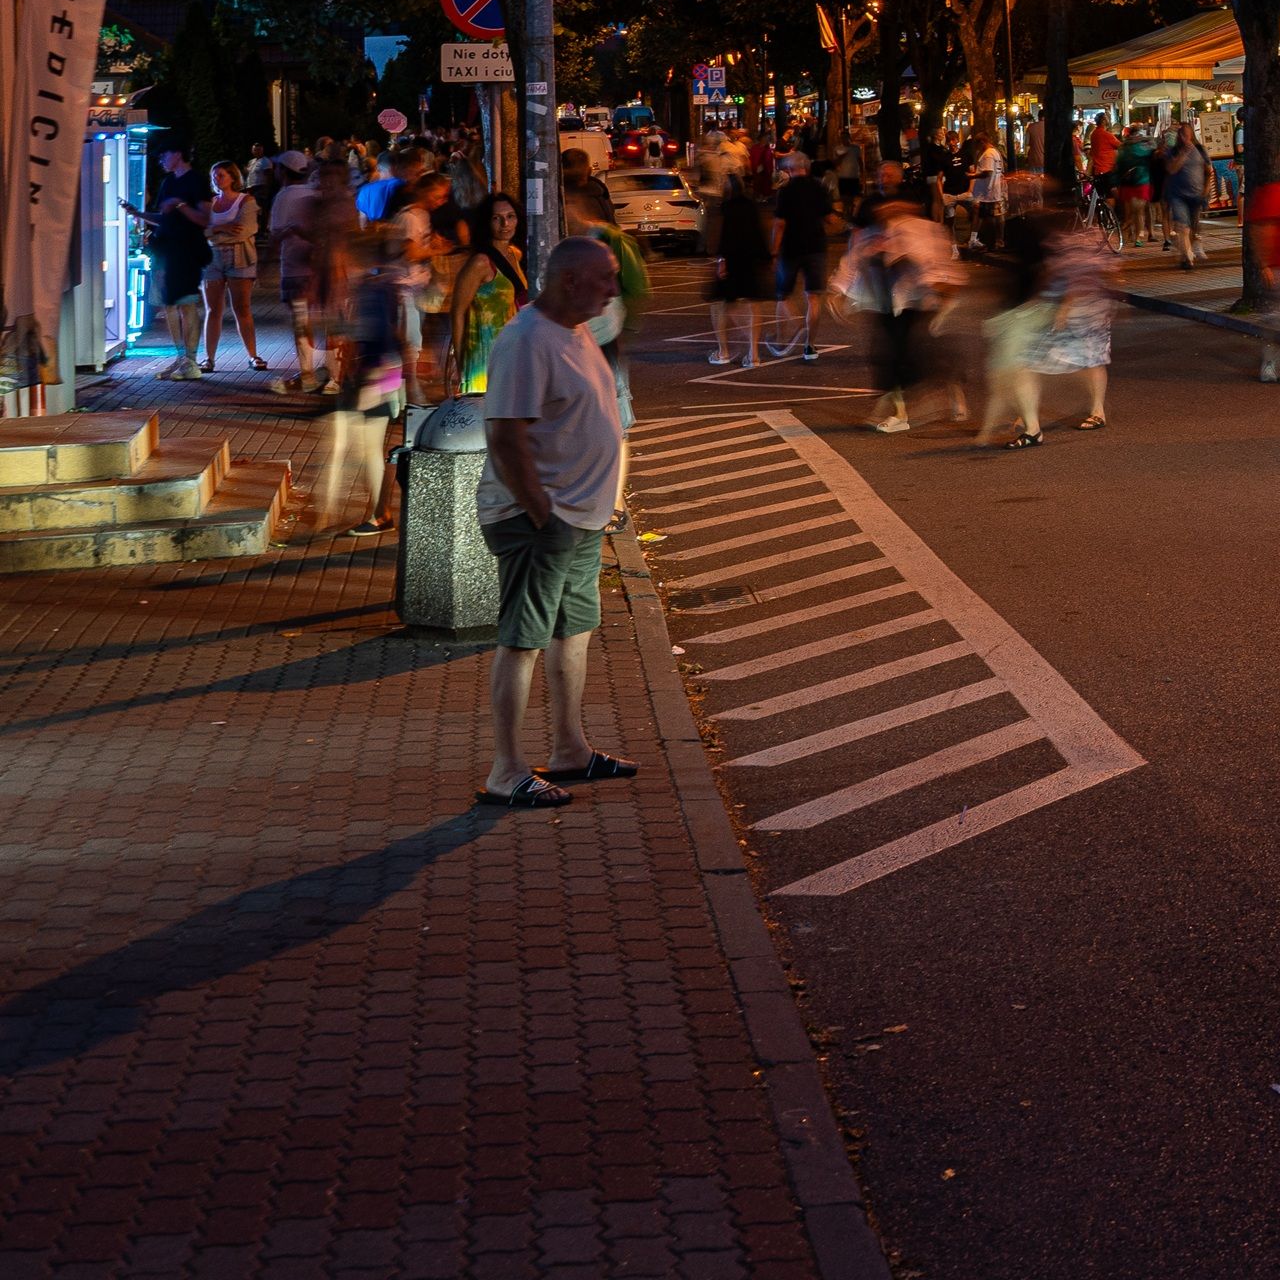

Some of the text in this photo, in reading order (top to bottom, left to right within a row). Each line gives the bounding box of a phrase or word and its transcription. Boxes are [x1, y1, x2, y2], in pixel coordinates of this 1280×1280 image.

[454, 49, 512, 61] Nie doty
[447, 66, 513, 77] TAXI i ciu
